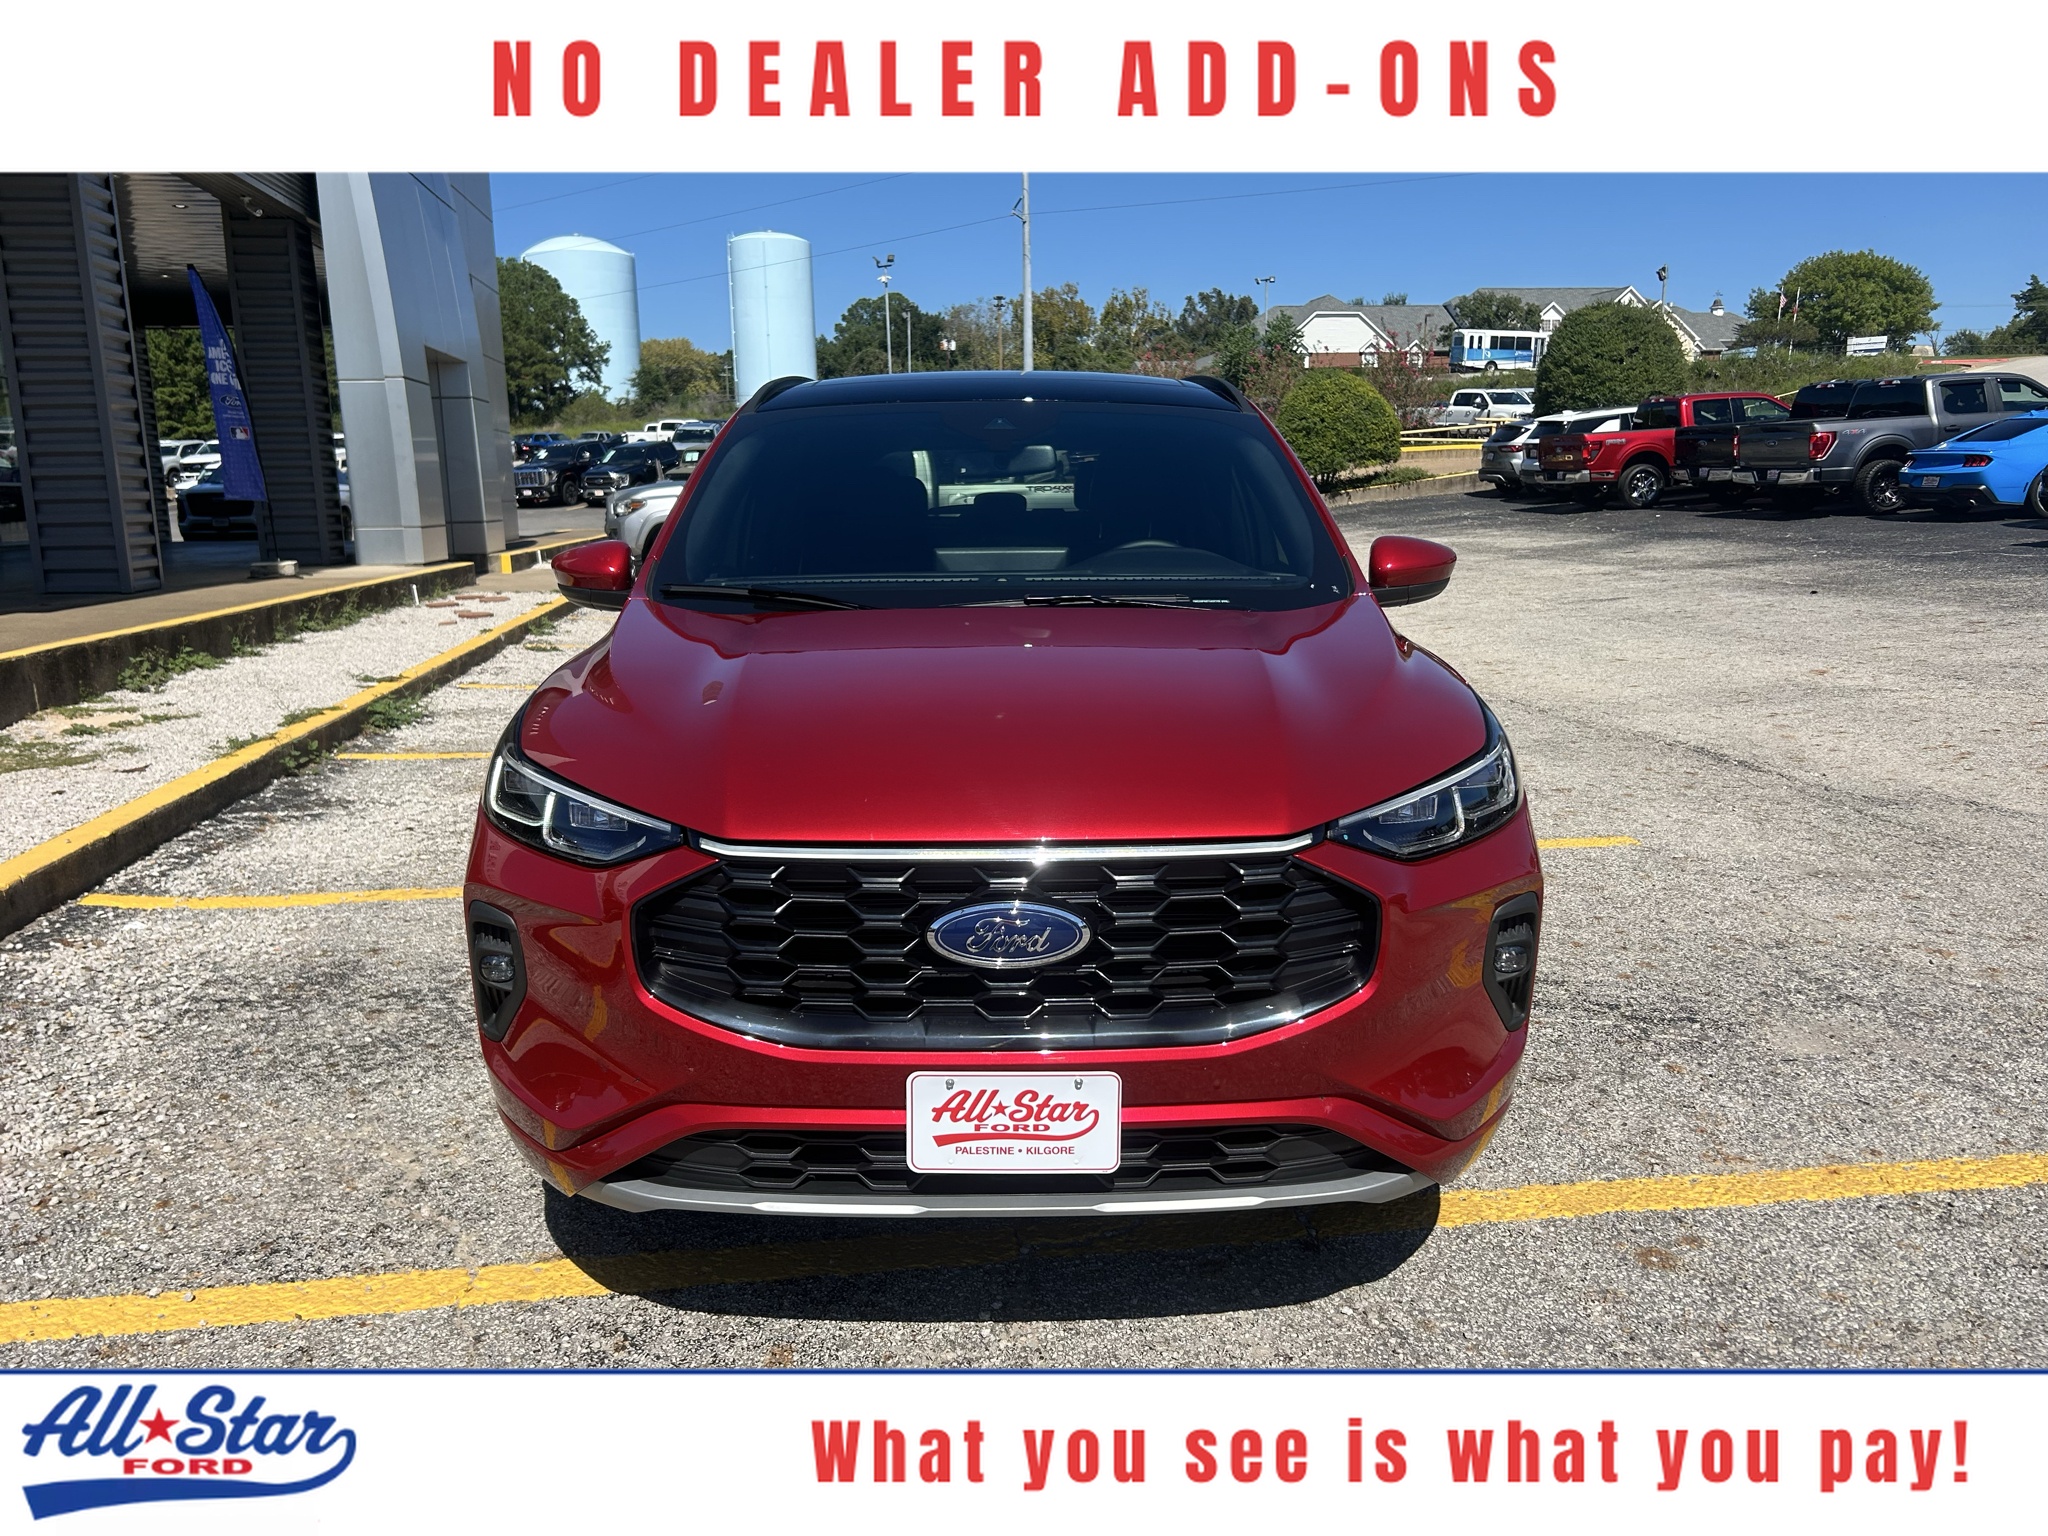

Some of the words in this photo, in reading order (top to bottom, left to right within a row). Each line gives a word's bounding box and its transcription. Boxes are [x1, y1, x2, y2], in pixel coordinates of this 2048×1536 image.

[966, 917, 1051, 953] Ford
[974, 1123, 1051, 1132] FORD
[955, 1146, 1015, 1155] PALESTINE
[1026, 1146, 1075, 1155] KILGORE
